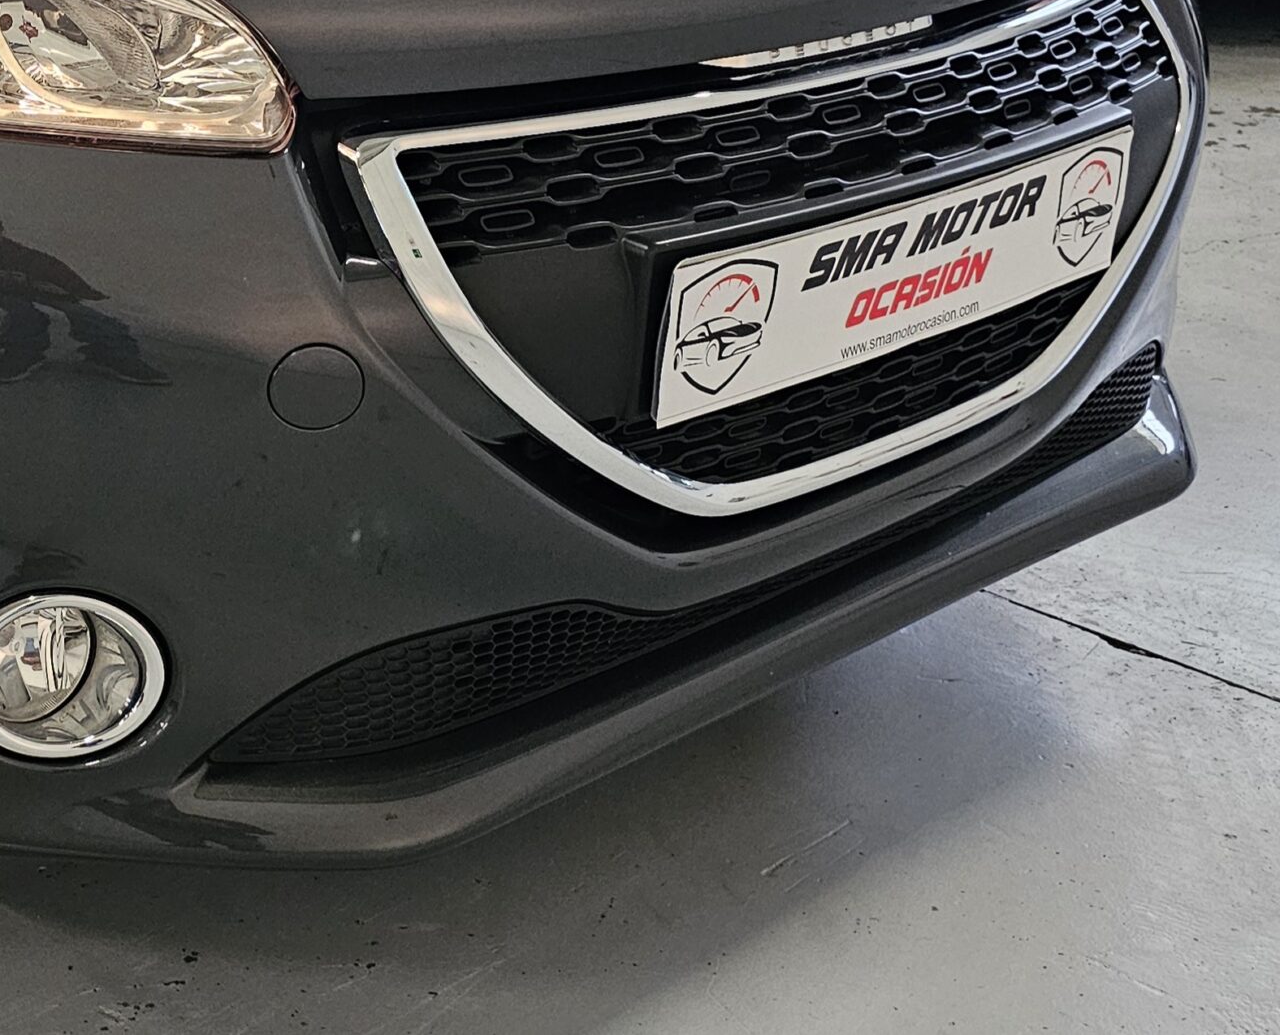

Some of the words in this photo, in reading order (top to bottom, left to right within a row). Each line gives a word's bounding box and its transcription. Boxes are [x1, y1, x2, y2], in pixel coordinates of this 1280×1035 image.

[801, 220, 908, 292] SMA
[907, 175, 1047, 256] MOTOR
[845, 246, 994, 329] OCASIÓN
[840, 301, 980, 359] www.smamotorocasion.com
